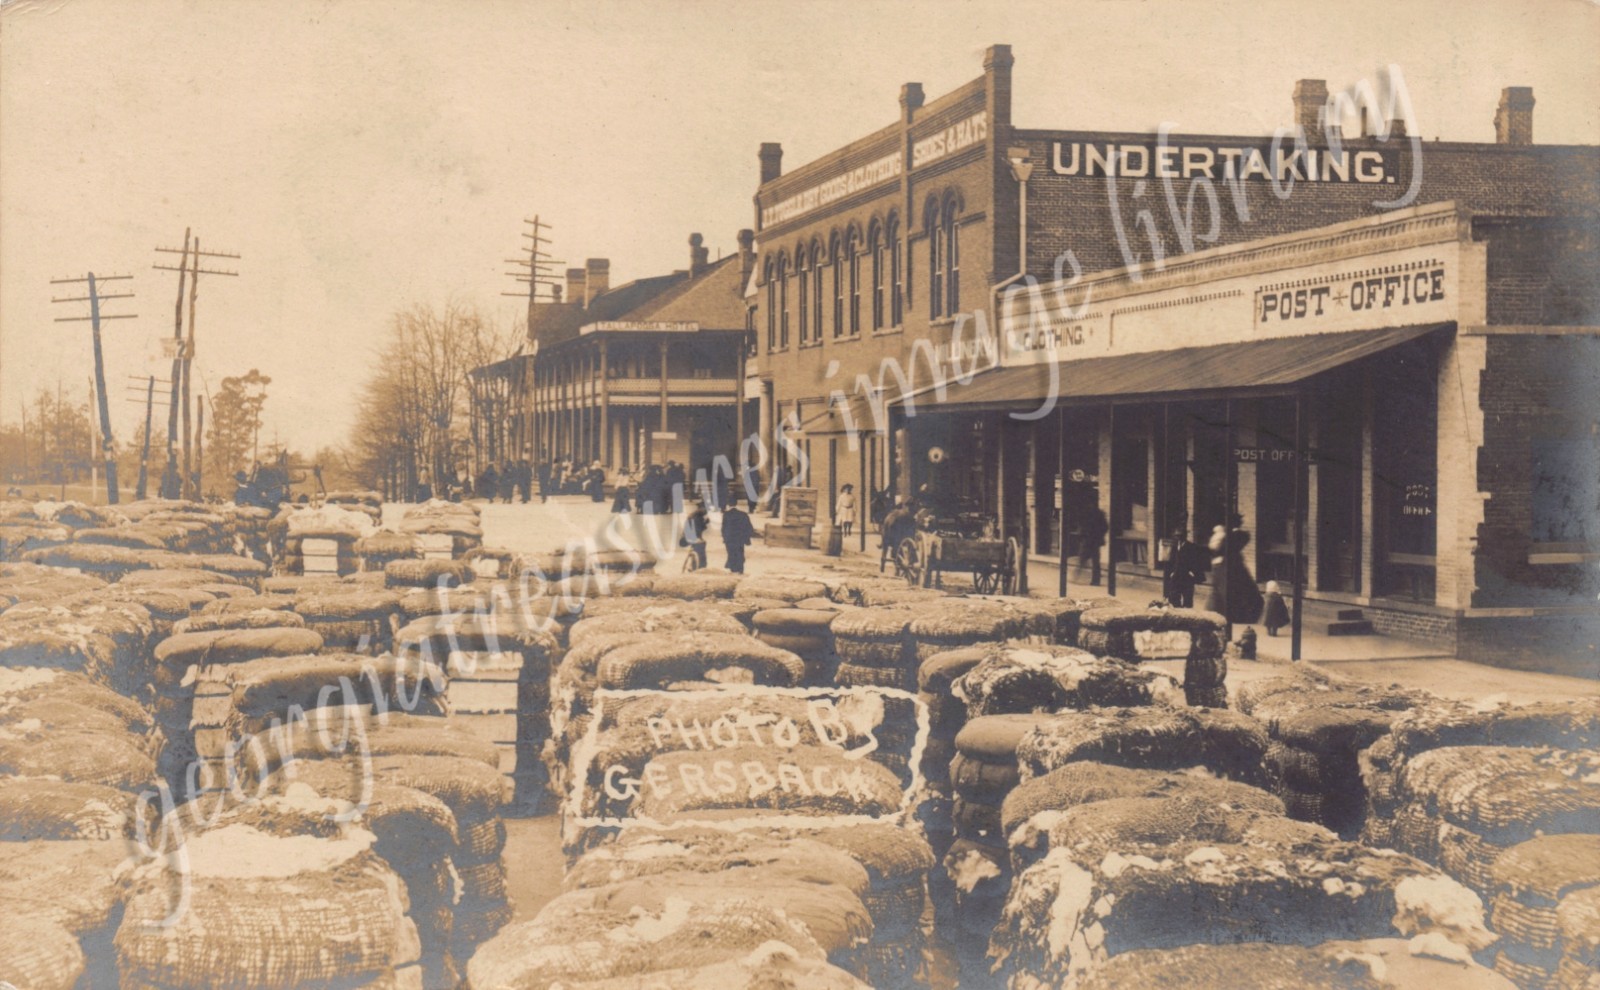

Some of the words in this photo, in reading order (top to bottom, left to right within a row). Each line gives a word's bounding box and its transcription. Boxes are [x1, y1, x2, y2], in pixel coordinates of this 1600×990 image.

[957, 112, 987, 150] HATS
[1052, 142, 1396, 184] UNDERTAKING.
[1261, 286, 1330, 322] POST
[1350, 269, 1445, 311] OFFICE
[1234, 449, 1266, 460] POST
[646, 707, 799, 751] PHOTO
[604, 760, 876, 801] GERSBACK
